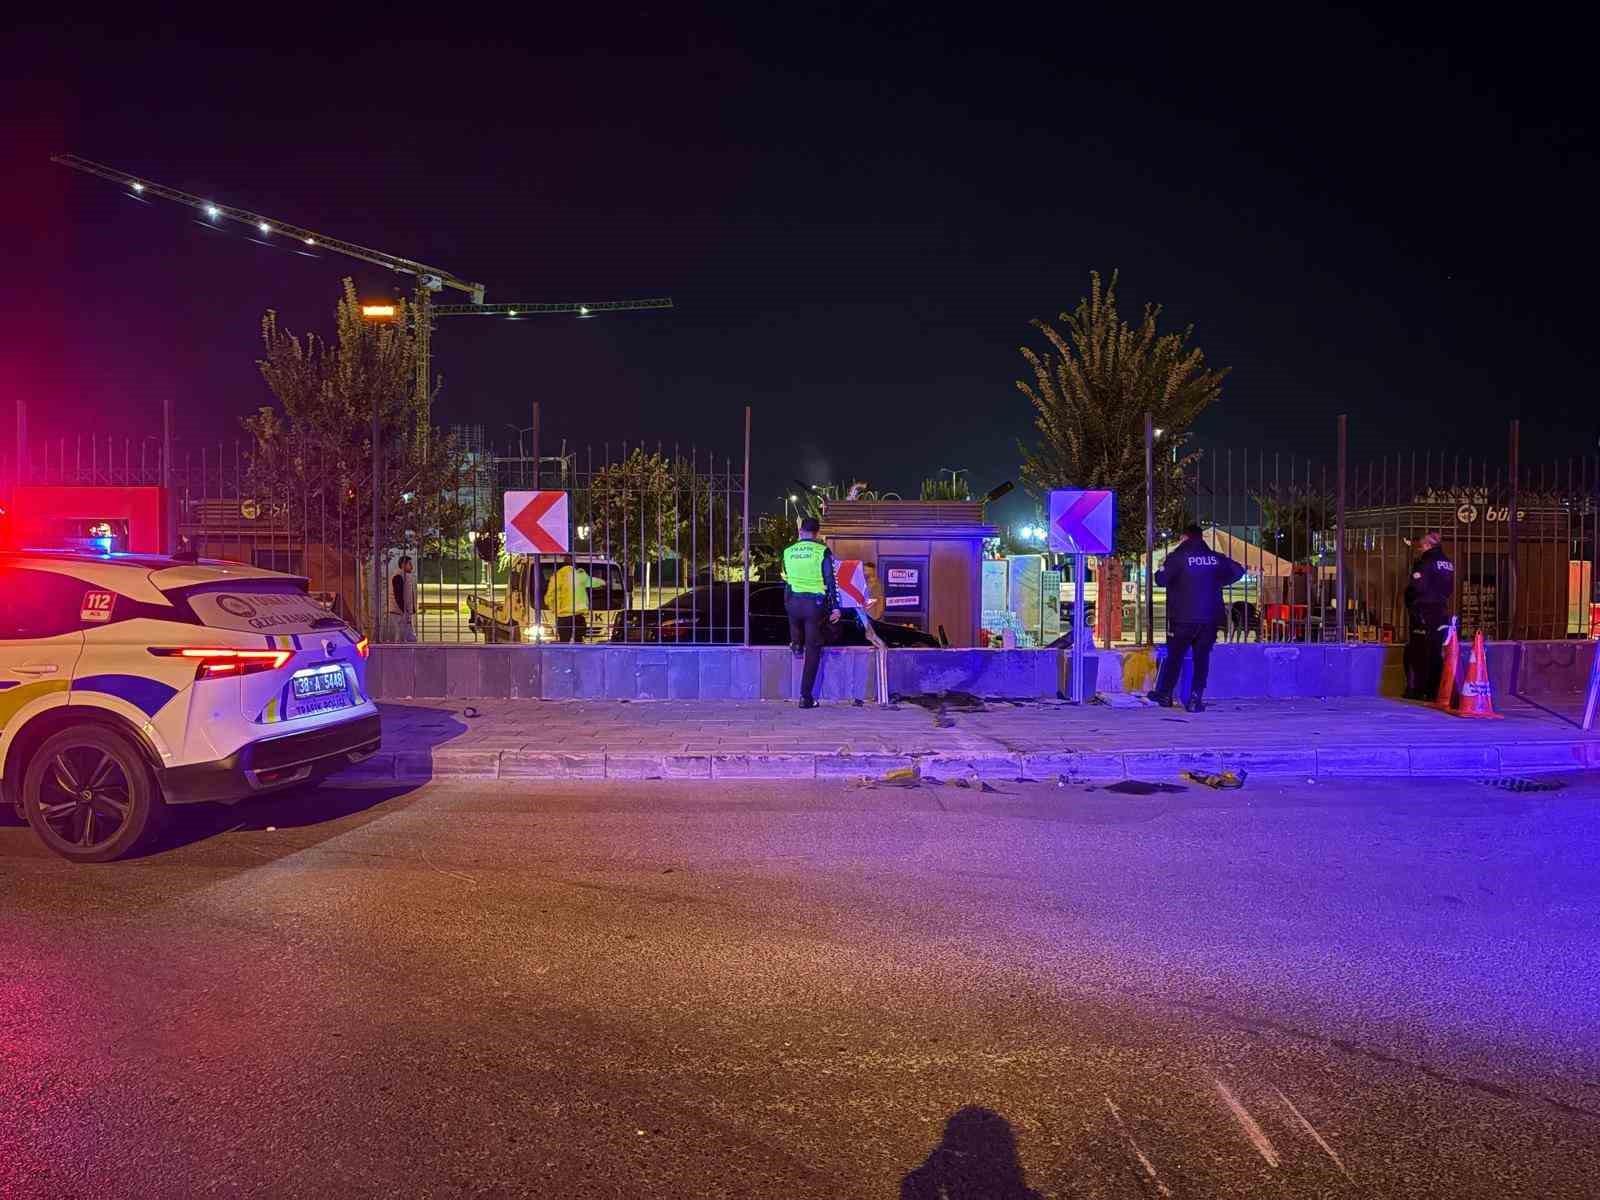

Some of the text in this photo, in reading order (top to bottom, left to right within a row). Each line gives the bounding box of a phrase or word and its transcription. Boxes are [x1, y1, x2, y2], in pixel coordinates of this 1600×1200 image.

[1486, 505, 1525, 522] büe
[87, 594, 111, 609] 112
[315, 676, 321, 691] A
